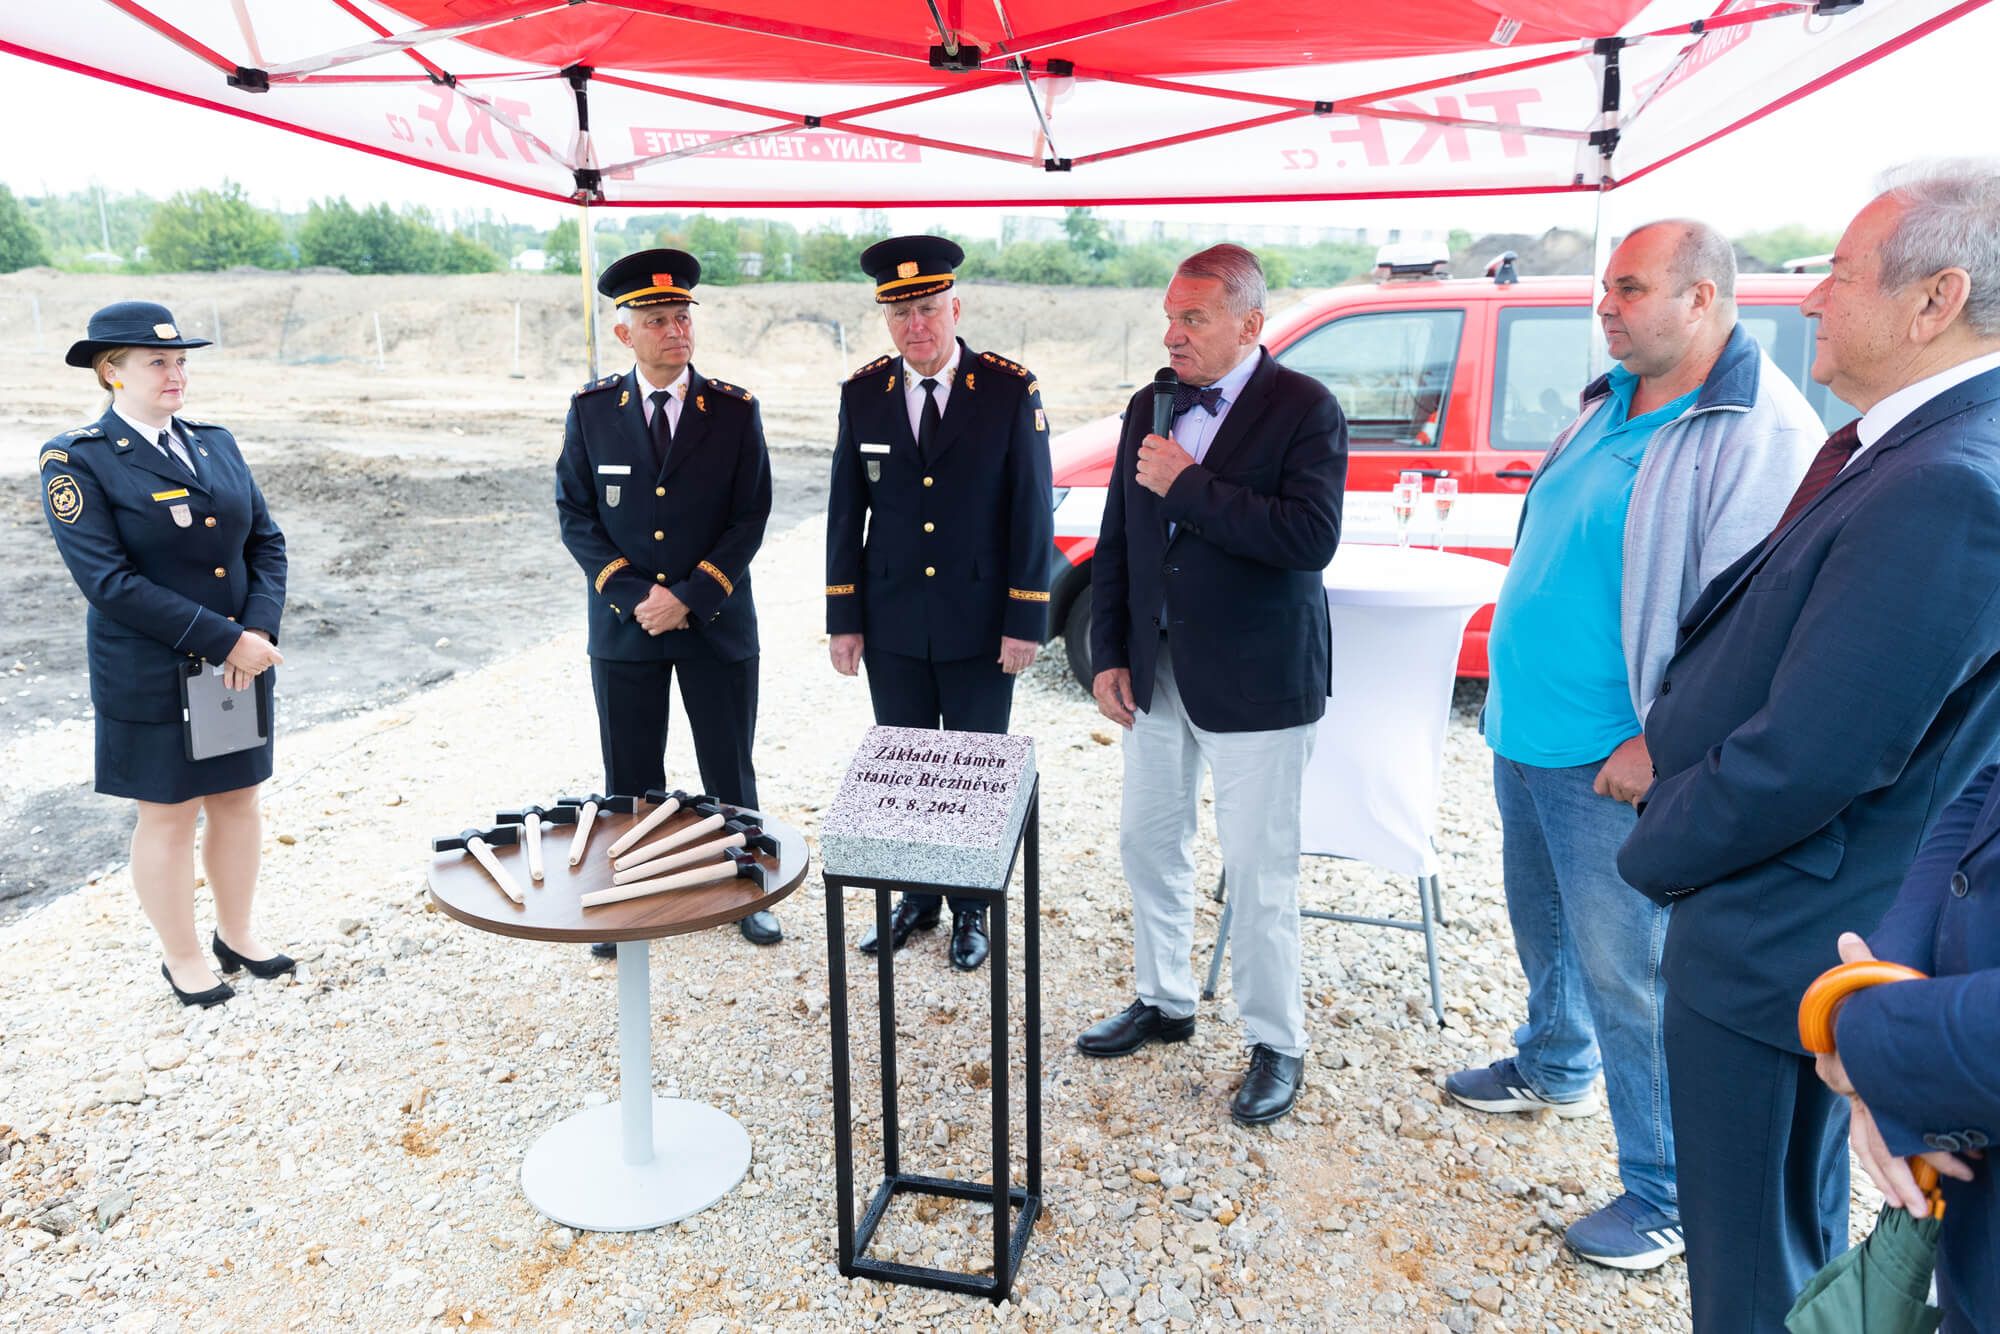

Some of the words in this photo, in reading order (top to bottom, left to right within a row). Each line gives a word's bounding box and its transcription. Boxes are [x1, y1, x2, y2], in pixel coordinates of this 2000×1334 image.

[876, 747, 948, 764] Základní
[953, 752, 1006, 768] kámen
[856, 770, 912, 785] stanice
[919, 772, 1007, 793] Březiněves
[879, 797, 899, 810] 19.
[906, 799, 920, 811] 8.
[929, 802, 967, 814] 2024
